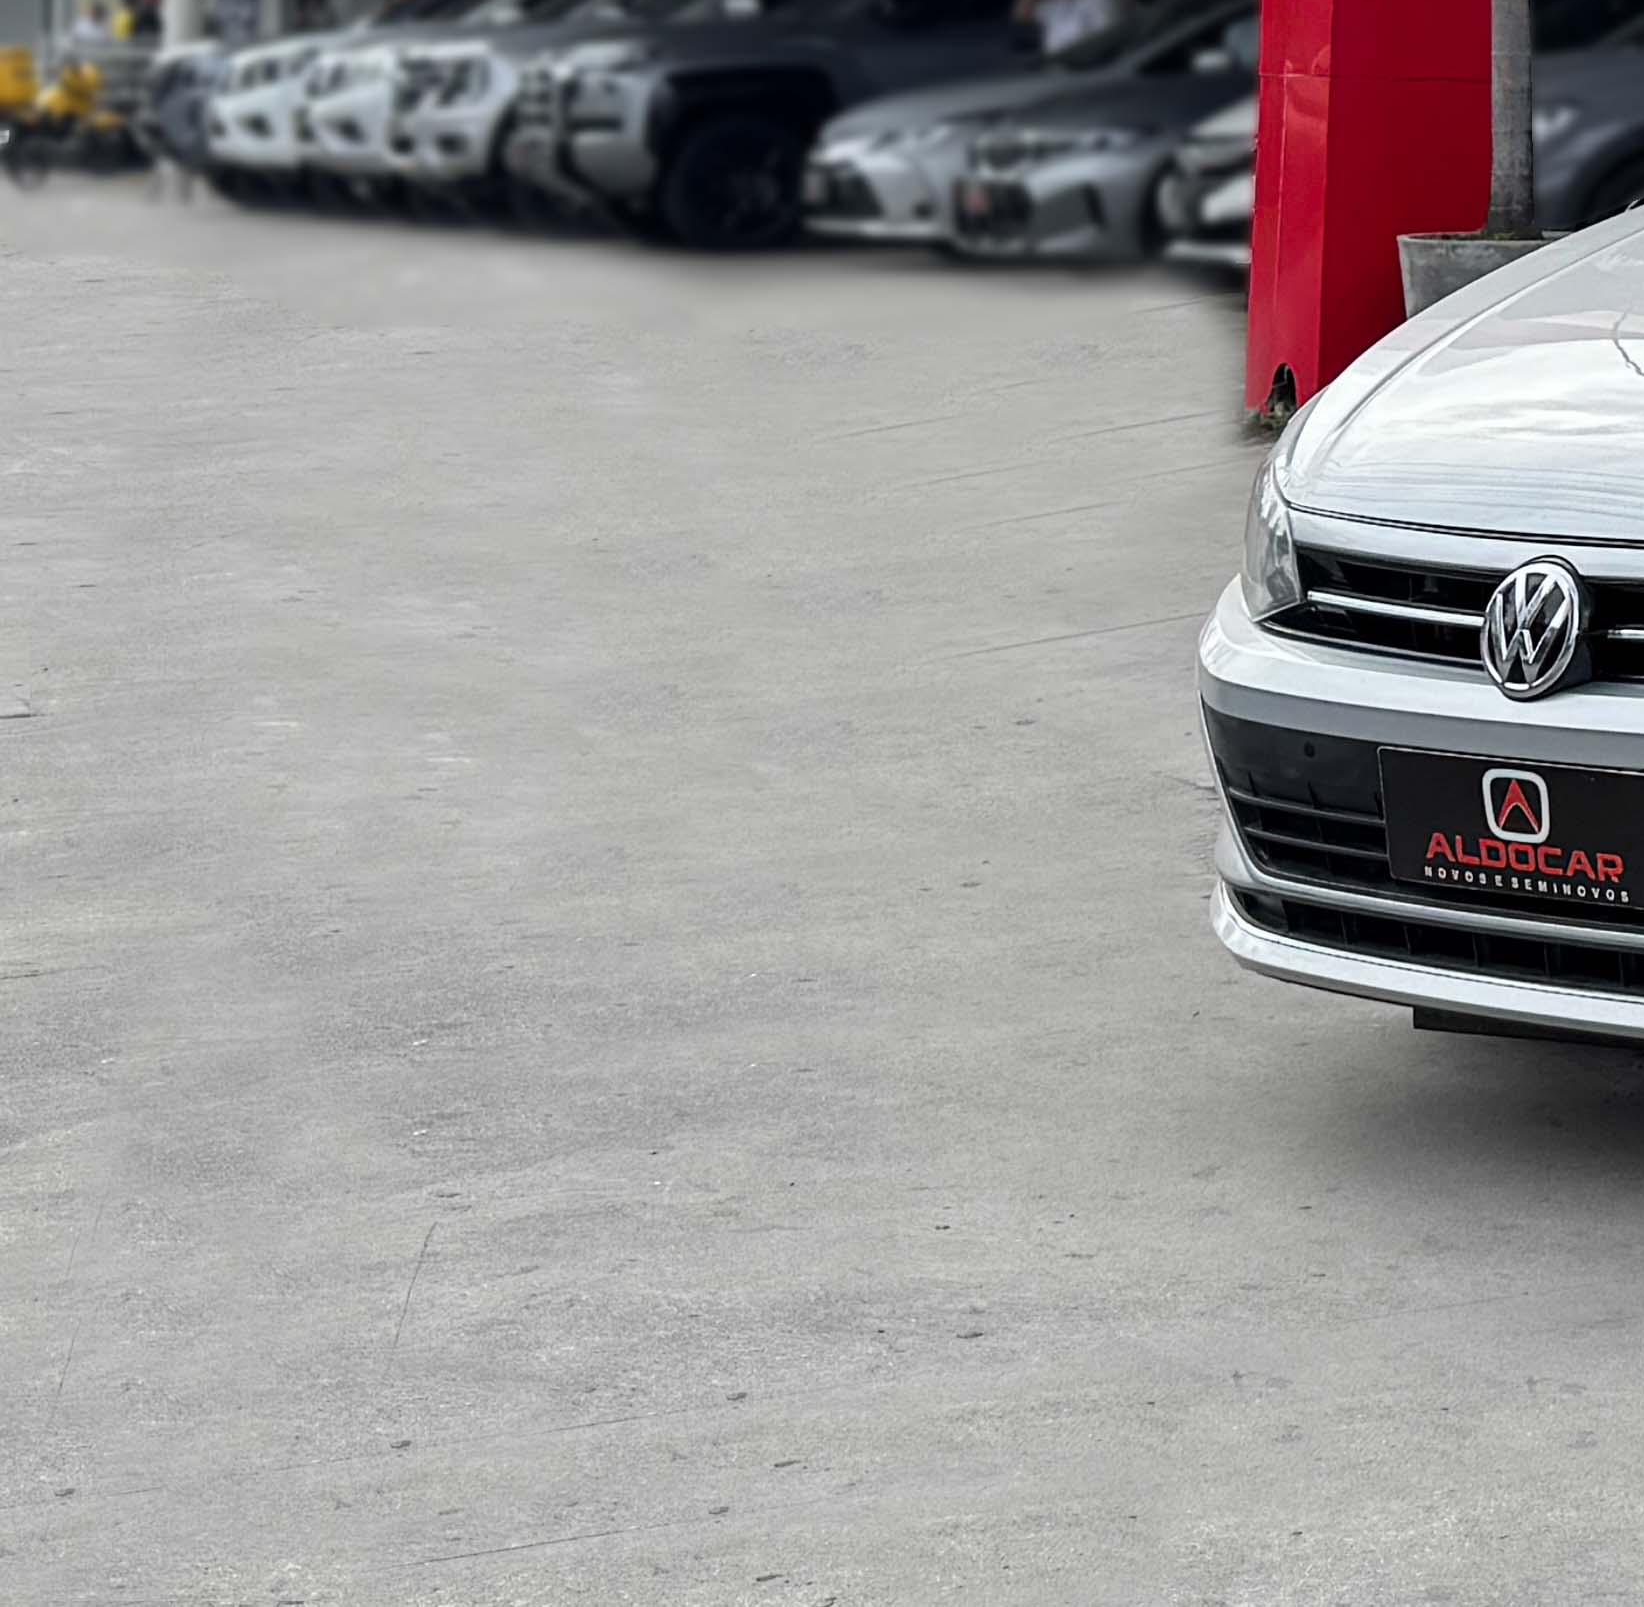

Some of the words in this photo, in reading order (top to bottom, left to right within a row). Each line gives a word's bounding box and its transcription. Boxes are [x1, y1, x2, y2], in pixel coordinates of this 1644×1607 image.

[1425, 831, 1624, 883] ALDOCAR
[1424, 865, 1487, 886] NOVOS
[1494, 874, 1504, 889] E
[1511, 875, 1630, 904] SEMINOVOS
